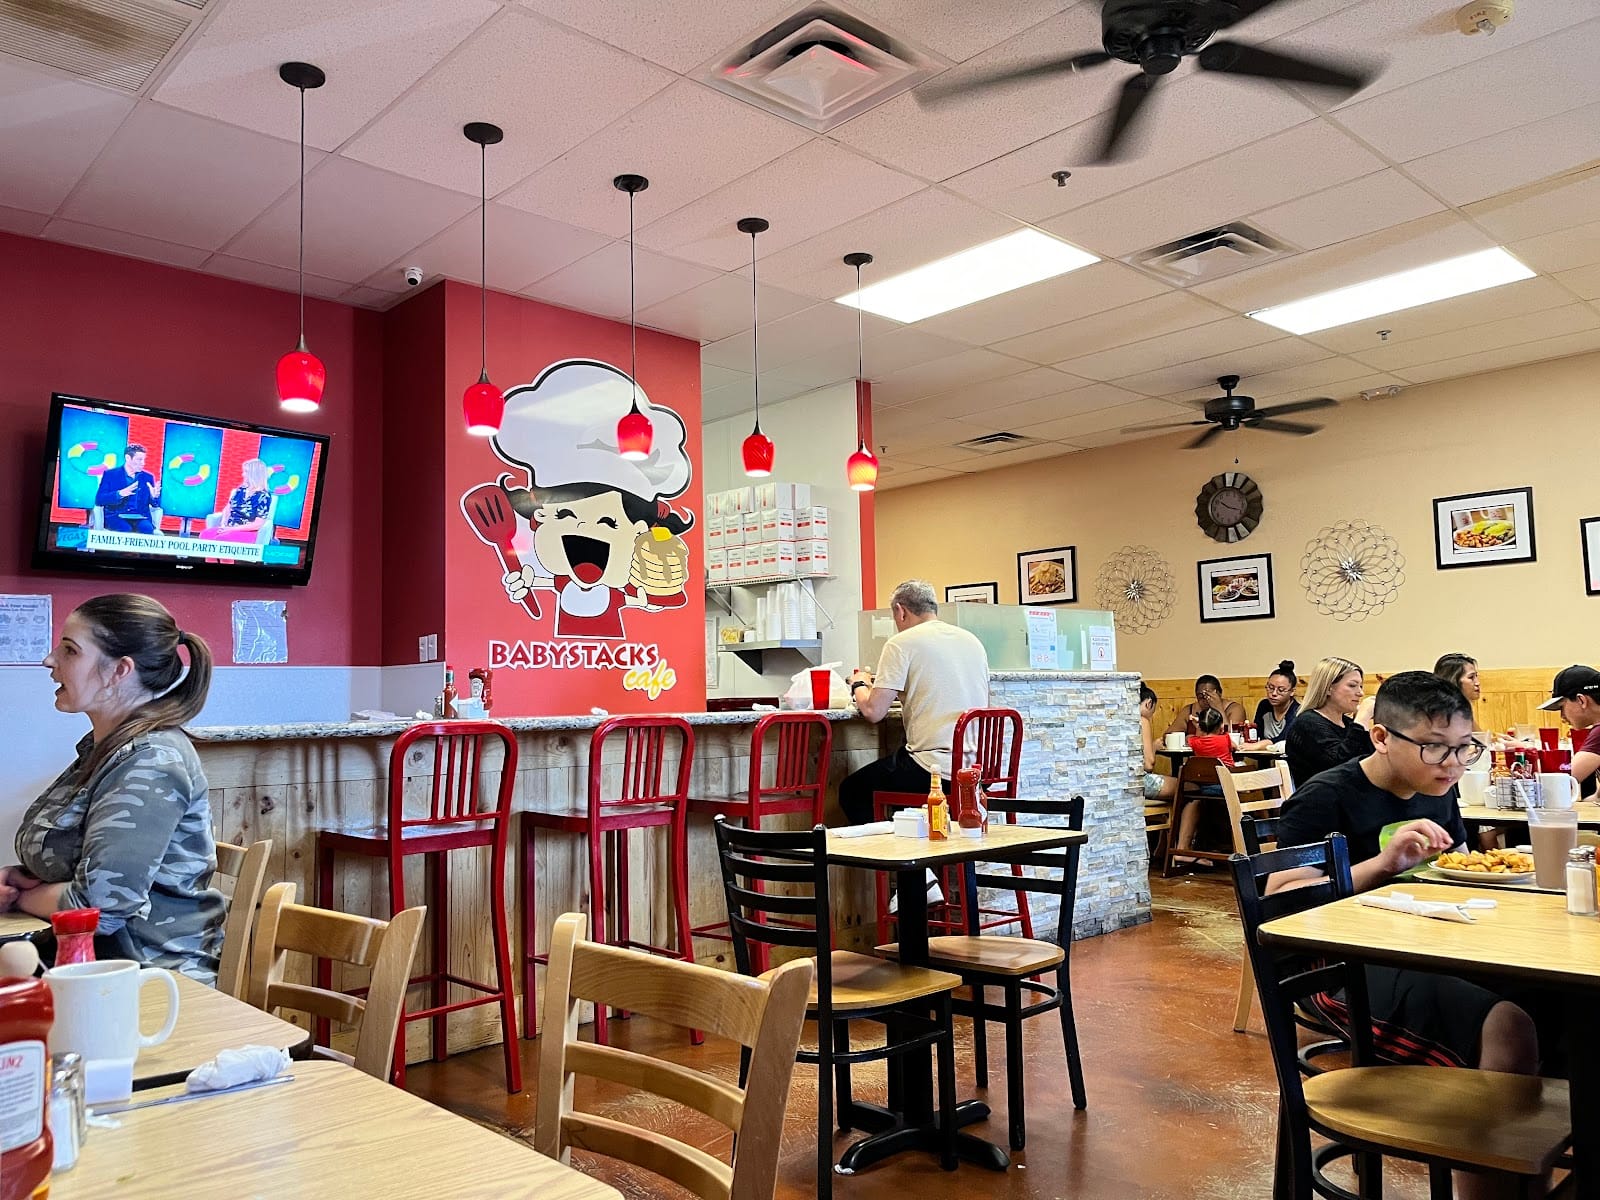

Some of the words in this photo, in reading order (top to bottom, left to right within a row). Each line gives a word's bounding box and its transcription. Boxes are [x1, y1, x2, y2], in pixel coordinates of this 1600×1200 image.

[91, 534, 166, 549] FAMILY-FRIENDLY
[168, 540, 190, 551] POOL
[191, 542, 217, 553] PARTY
[219, 545, 260, 556] ETIQUETTE
[490, 641, 659, 669] BABYSTACKS
[624, 659, 676, 699] cafe
